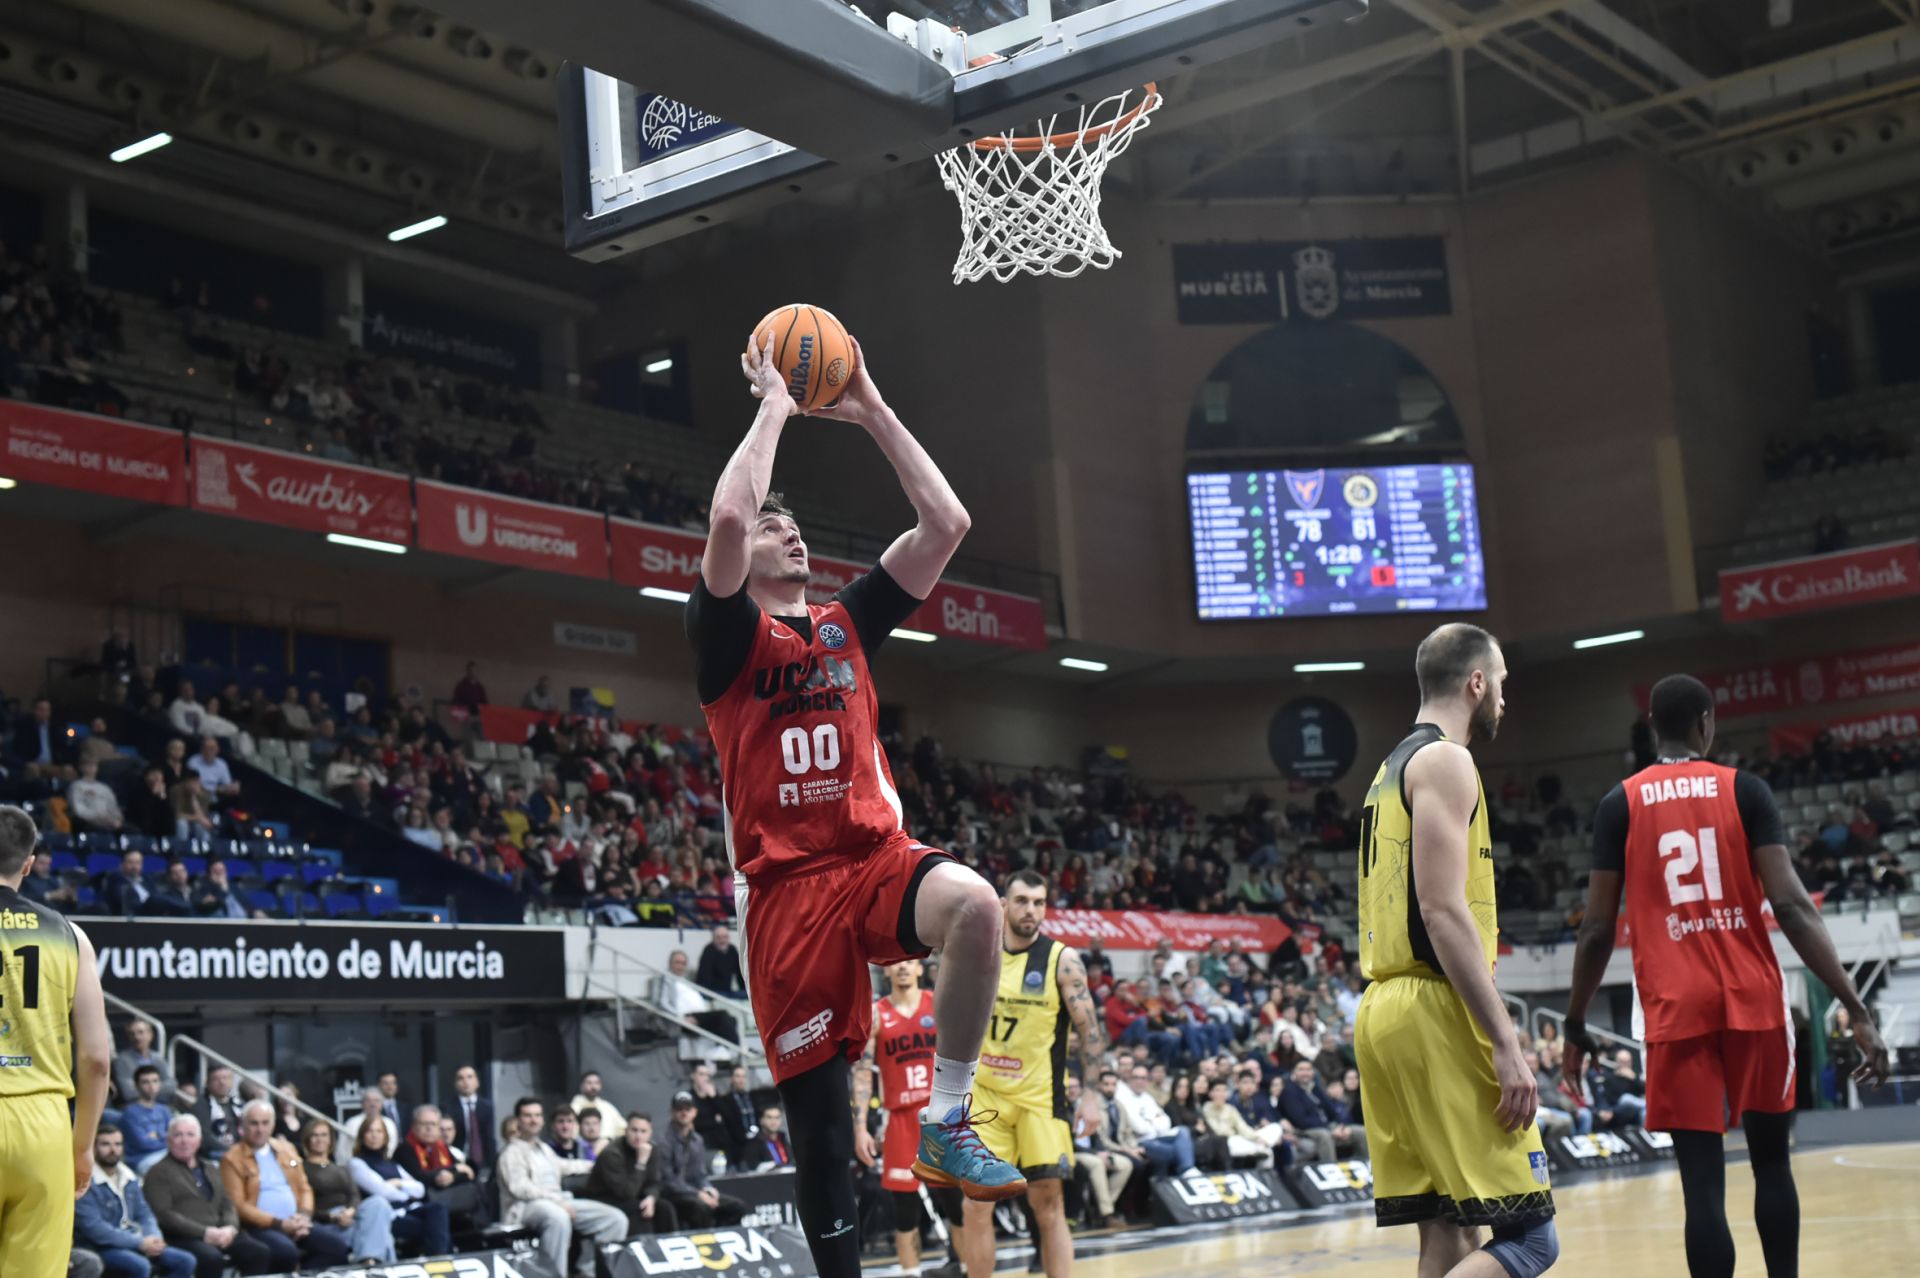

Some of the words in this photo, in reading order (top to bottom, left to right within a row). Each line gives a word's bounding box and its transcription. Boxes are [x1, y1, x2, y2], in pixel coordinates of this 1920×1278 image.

[1366, 284, 1422, 299] Murcia
[788, 335, 814, 402] Wilson
[79, 450, 102, 471] DE
[106, 454, 170, 481] MURCIA
[493, 529, 578, 559] URDECON
[1294, 518, 1323, 543] 78
[1352, 517, 1376, 541] 61
[1315, 544, 1363, 566] 1:28
[1770, 558, 1909, 605] CaixaBank
[941, 594, 1001, 639] Barin
[755, 656, 857, 701] UCAM
[769, 691, 847, 721] MURCIA
[780, 723, 841, 775] 00
[802, 778, 839, 790] CARAVACA
[822, 785, 839, 794] CRUZ
[1640, 775, 1719, 807] DIAGNE
[1479, 847, 1494, 860] FA
[1658, 826, 1723, 906] 21
[0, 907, 39, 930] ács
[1681, 915, 1748, 936] MURCIA
[96, 936, 330, 979] yuntamiento
[337, 938, 382, 979] de
[389, 939, 504, 979] Murcia
[0, 944, 40, 1010] 1
[776, 1008, 834, 1056] ESP
[885, 1030, 937, 1057] UCAM
[990, 1015, 1019, 1042] 17
[905, 1065, 929, 1090] 12
[629, 1228, 783, 1276] LIBERA
